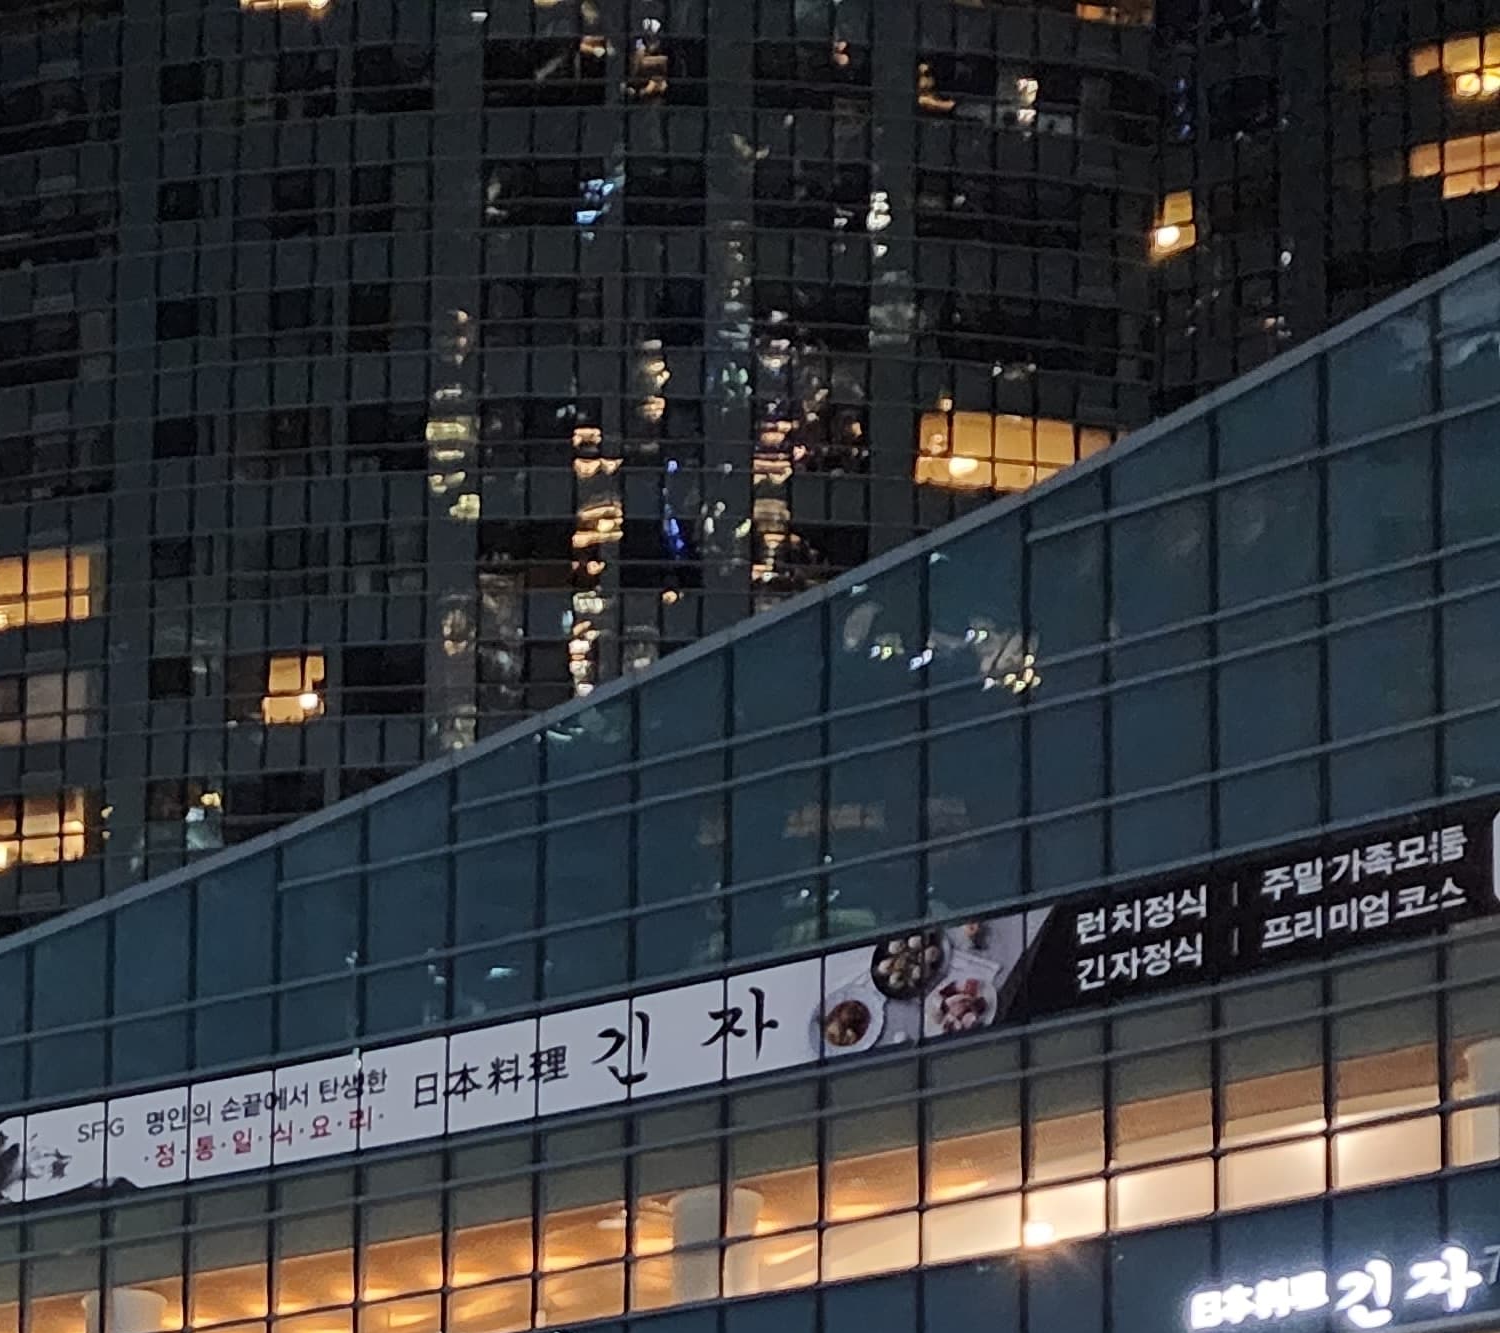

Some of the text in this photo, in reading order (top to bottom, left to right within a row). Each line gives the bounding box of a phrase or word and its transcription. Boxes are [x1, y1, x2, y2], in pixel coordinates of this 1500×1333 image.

[1076, 884, 1207, 945] 런치정식
[1077, 932, 1203, 991] 긴자정식
[146, 1068, 388, 1136] 명인의 손끝에서 탄생한
[414, 1045, 569, 1109] 日本料理
[77, 1118, 125, 1143] SFG
